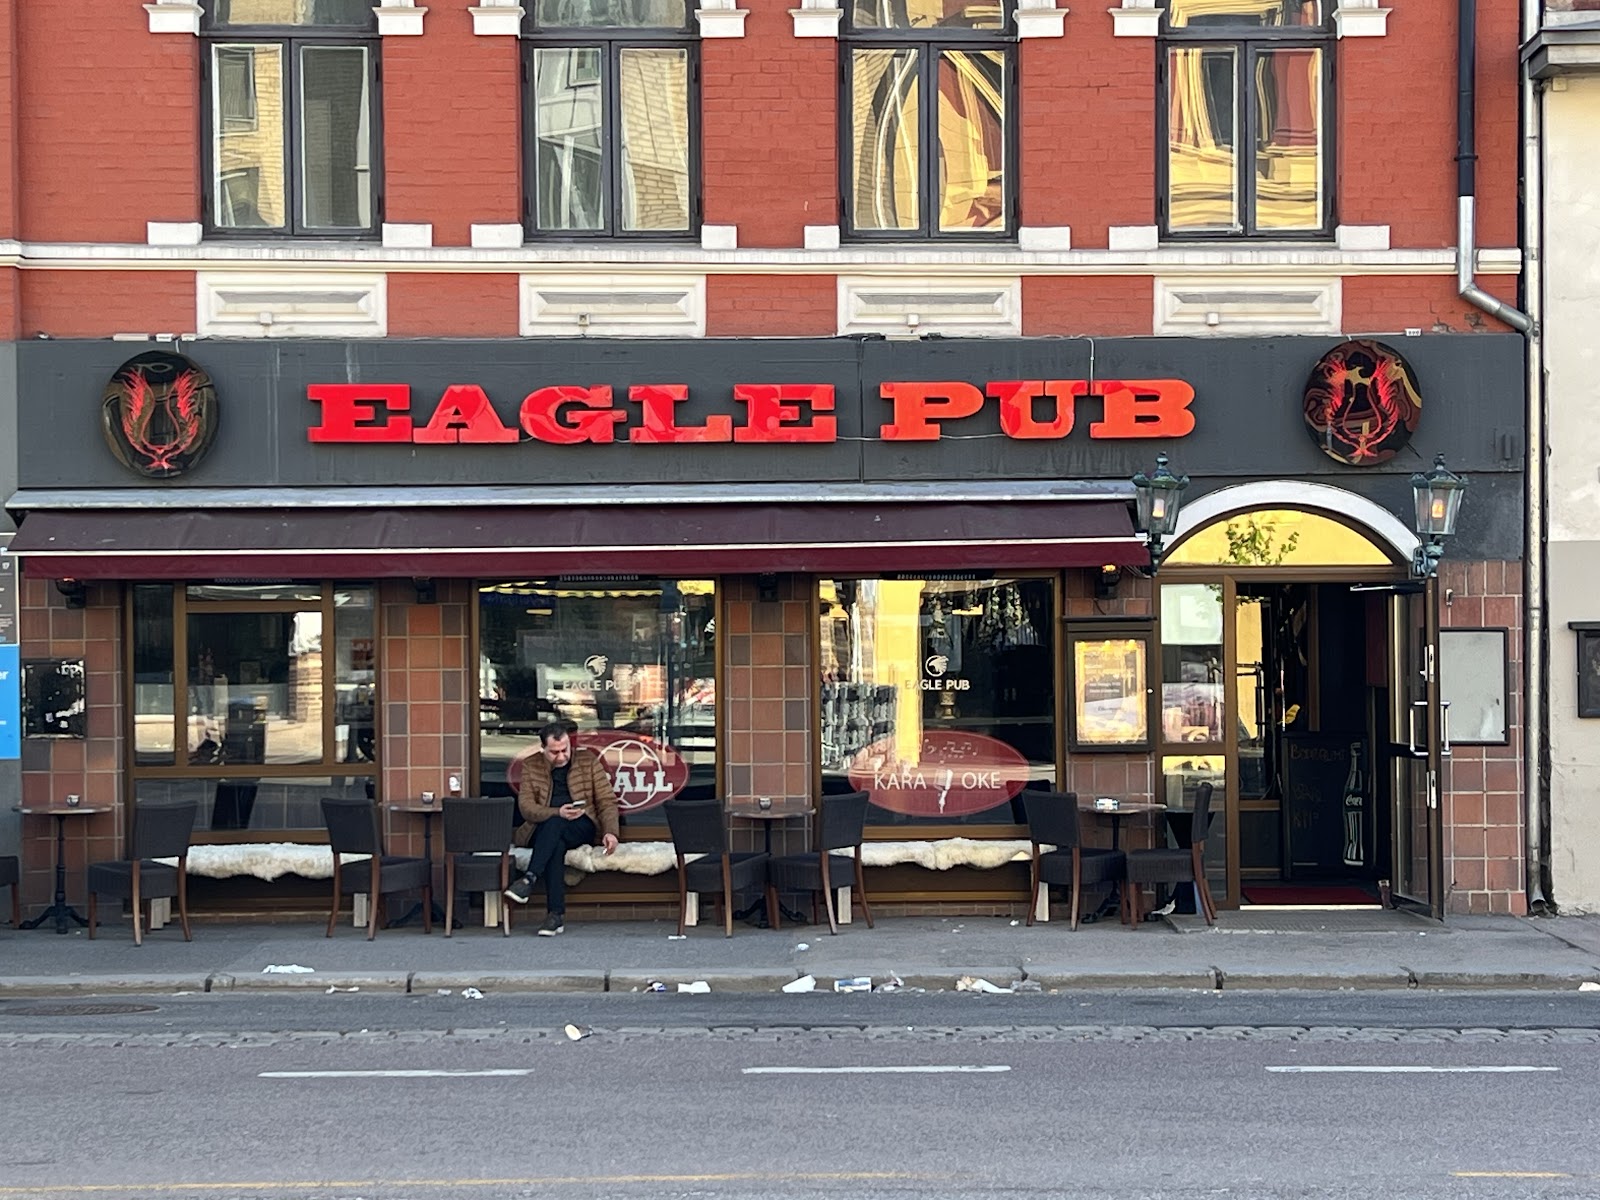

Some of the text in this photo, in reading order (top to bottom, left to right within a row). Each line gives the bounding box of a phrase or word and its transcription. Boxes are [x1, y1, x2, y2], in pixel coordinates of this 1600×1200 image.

[307, 379, 1196, 444] EAGLE PUB
[563, 680, 630, 692] EAGLE PU
[904, 679, 971, 691] EAGLE PUB
[606, 771, 674, 793] ALL
[873, 771, 1002, 791] KARA OKE
